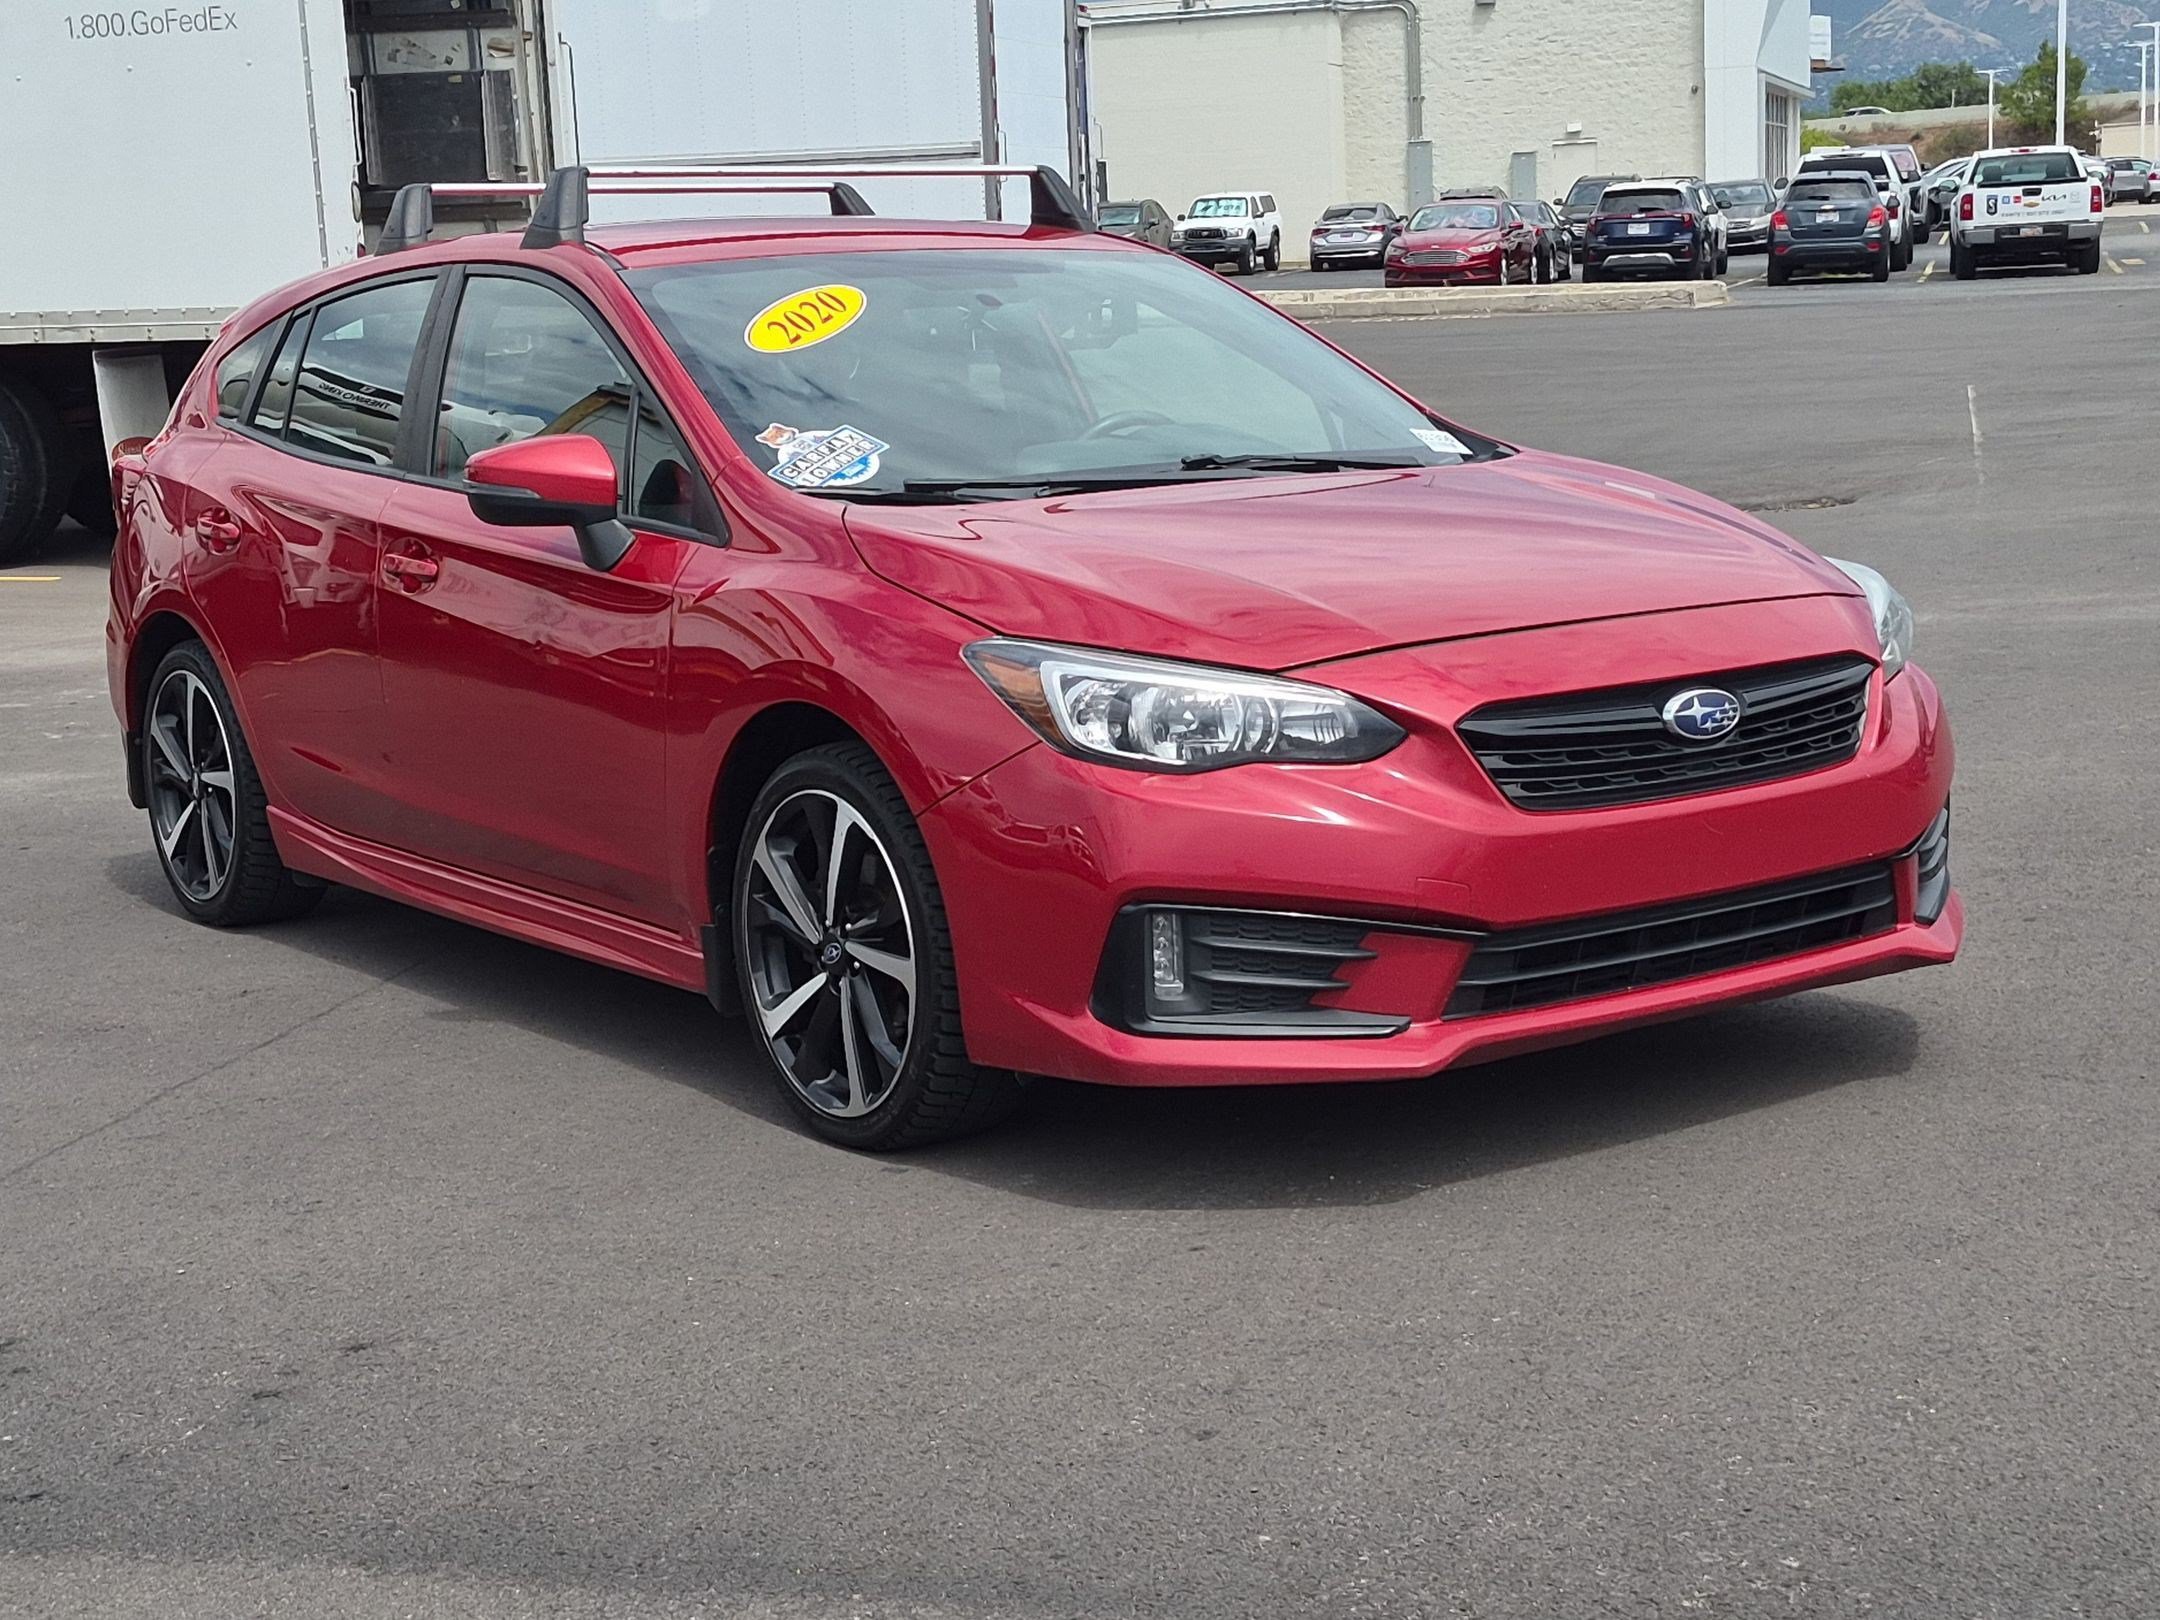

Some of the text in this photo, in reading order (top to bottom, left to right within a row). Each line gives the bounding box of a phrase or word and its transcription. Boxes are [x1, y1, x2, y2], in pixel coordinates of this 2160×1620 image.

[64, 6, 238, 40] 1.800.GoFedEx
[767, 291, 846, 344] 2020
[782, 434, 859, 478] CARFAX
[809, 438, 875, 480] OWNER
